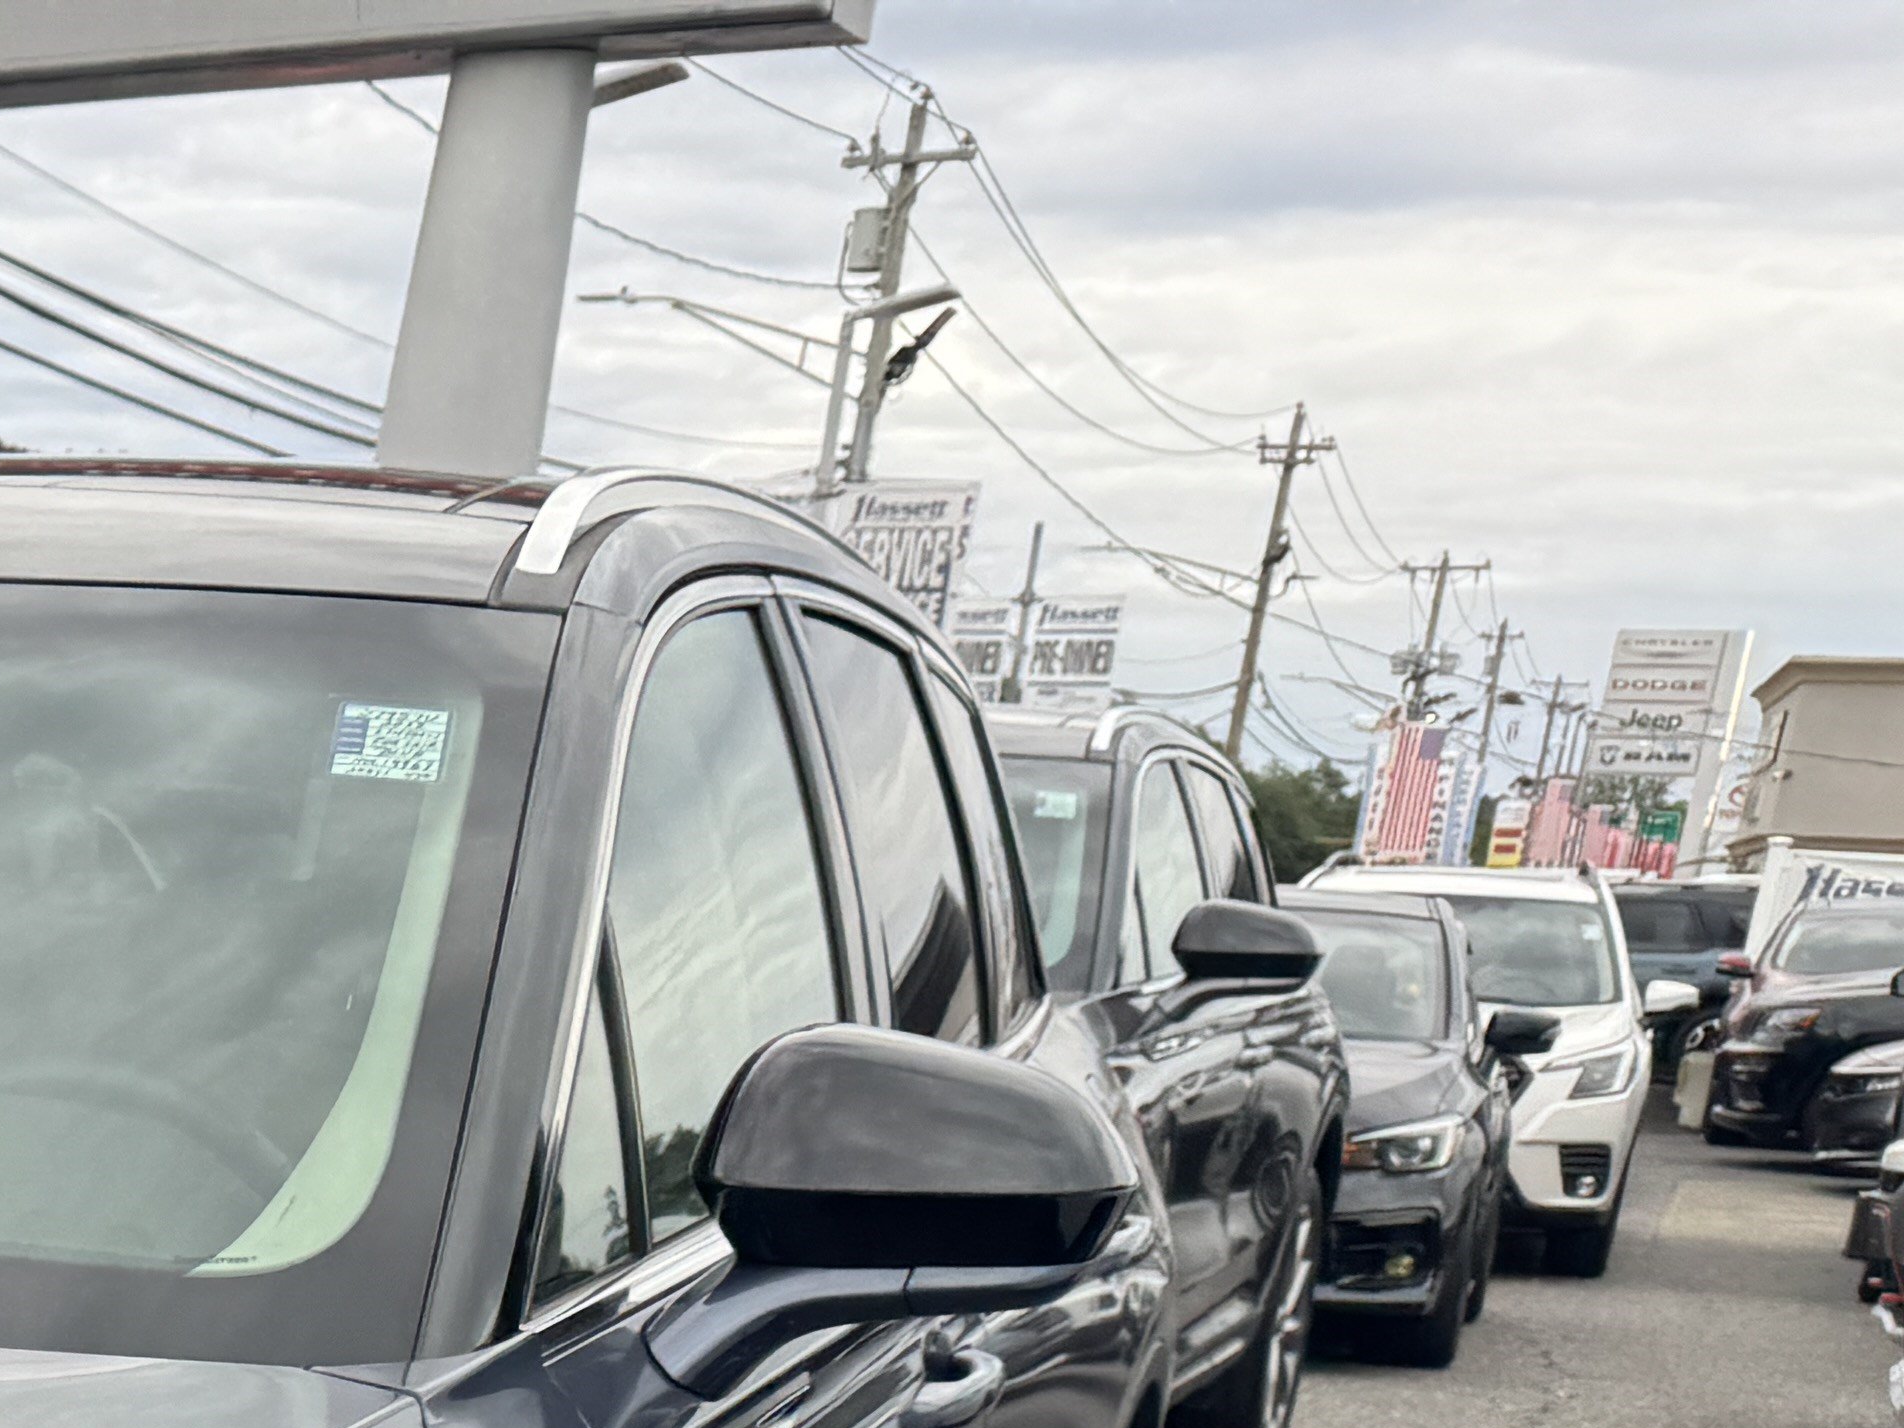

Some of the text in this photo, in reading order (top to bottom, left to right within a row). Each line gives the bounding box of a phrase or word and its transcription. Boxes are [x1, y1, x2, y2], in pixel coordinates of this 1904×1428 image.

[841, 526, 952, 590] ERVICE
[1611, 679, 1707, 692] DODGE
[1620, 708, 1683, 731] Jeep
